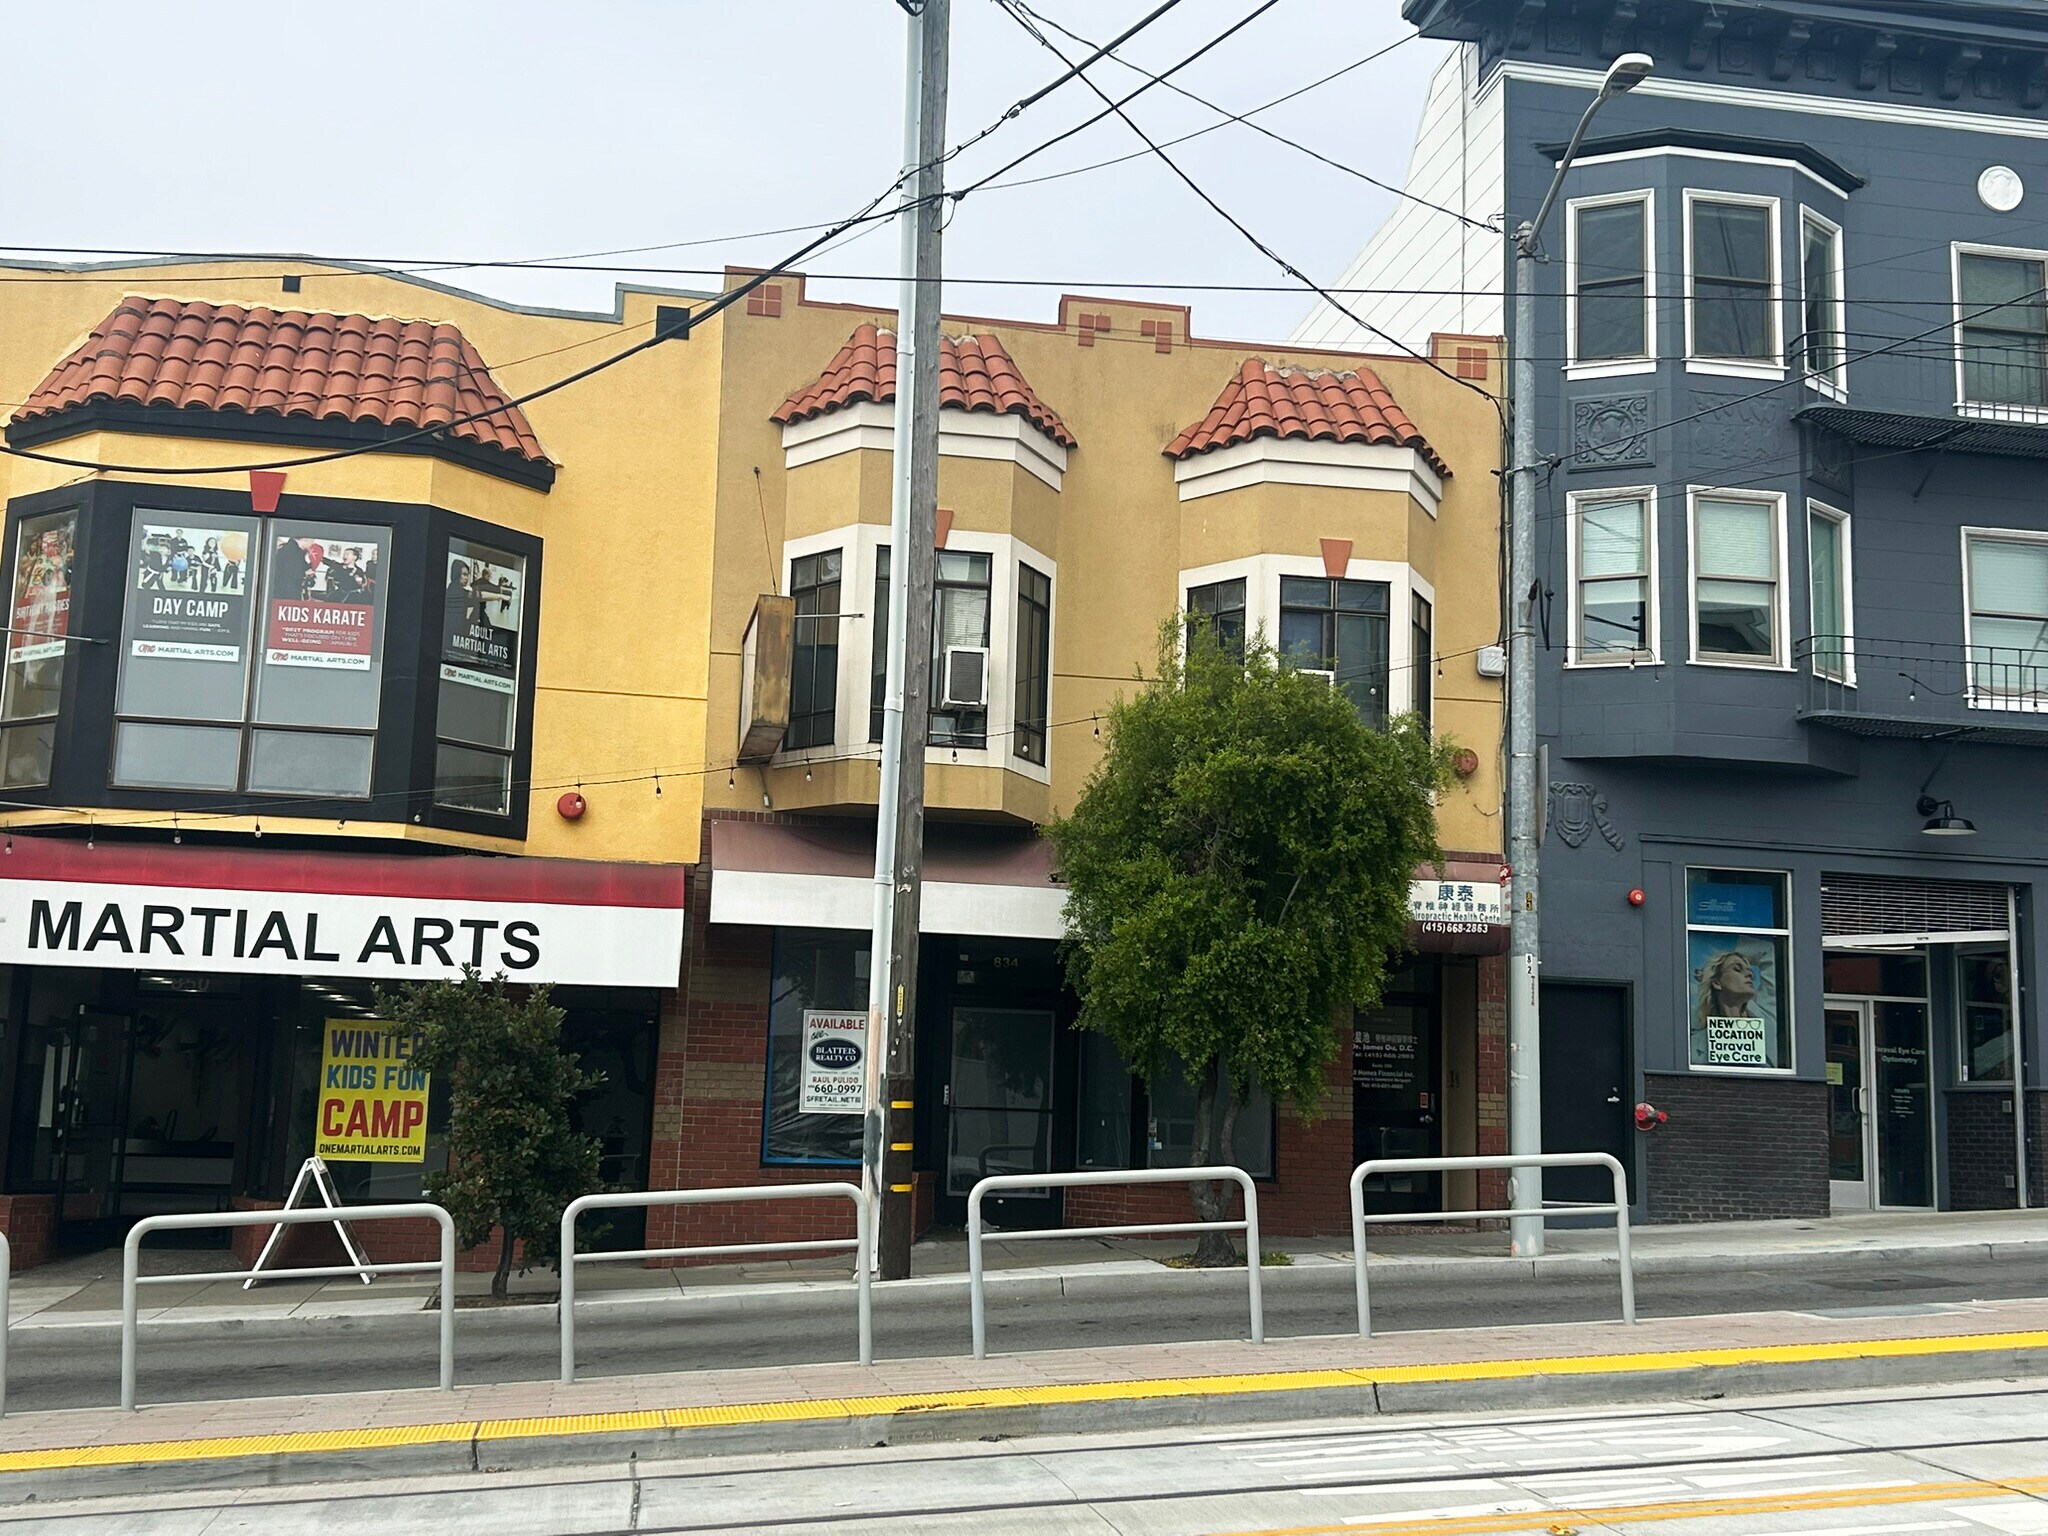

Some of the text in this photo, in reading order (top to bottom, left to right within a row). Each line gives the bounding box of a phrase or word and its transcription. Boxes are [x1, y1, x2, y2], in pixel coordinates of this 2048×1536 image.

[153, 597, 229, 618] DAY CAMP
[278, 605, 367, 627] KIDS KARATE
[469, 624, 494, 641] ADULT
[158, 646, 192, 655] MARTIAL
[194, 649, 234, 657] ARTS.COM
[452, 634, 509, 660] MARTIAL ARTS
[290, 655, 324, 663] MARTIAL
[326, 657, 365, 665] ARTS.COM
[458, 672, 482, 683] MARTIAL
[483, 678, 511, 689] ARTS.COM
[1437, 884, 1474, 902] 康泰
[1453, 912, 1478, 922] Health
[27, 899, 541, 970] MARTIAL ARTS
[993, 956, 1019, 968] 834
[809, 1018, 865, 1030] AVAILABLE
[1709, 1019, 1735, 1029] NEW
[1709, 1030, 1763, 1040] LOCATION
[816, 1046, 857, 1054] BLATTEIS
[1363, 1043, 1383, 1051] James
[1709, 1040, 1755, 1052] Taraval
[1898, 1047, 1910, 1056] Eye
[1709, 1051, 1762, 1064] Eye Care
[1881, 1055, 1918, 1065] Optometry
[326, 1064, 426, 1092] KIDS FUN
[812, 1076, 859, 1084] RAUL PULIDO
[814, 1084, 863, 1094] 660-0997
[322, 1098, 424, 1138] CAMP
[319, 1143, 421, 1156] ONEMARTIALARTS.COM
